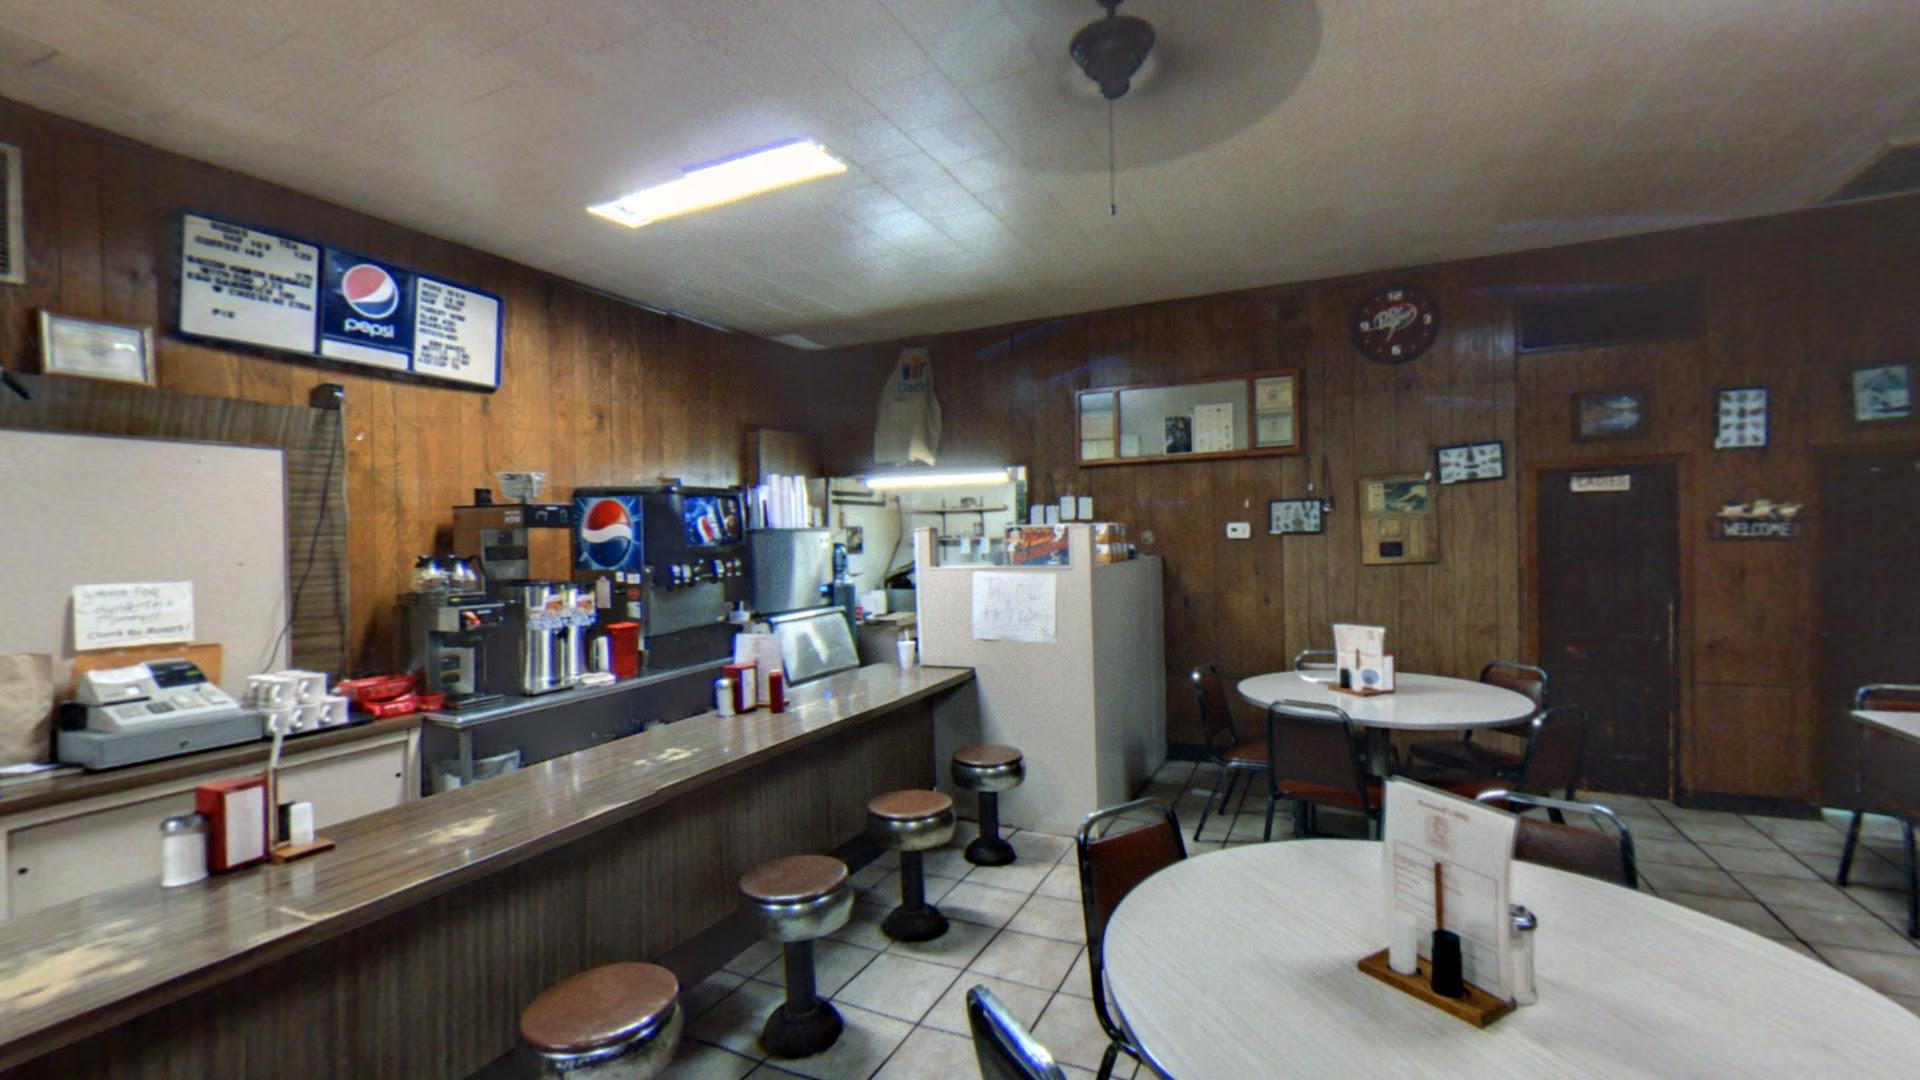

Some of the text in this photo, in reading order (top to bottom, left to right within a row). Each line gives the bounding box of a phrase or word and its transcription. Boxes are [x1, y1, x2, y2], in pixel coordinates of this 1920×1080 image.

[194, 236, 239, 253] COFFEE
[187, 254, 226, 269] BACON
[215, 276, 273, 297] SANDWICH
[1388, 291, 1403, 301] 12
[212, 307, 235, 319] PIE
[343, 318, 395, 339] pepsi
[1359, 313, 1432, 332] 9 3
[1391, 344, 1402, 355] 6
[1723, 522, 1793, 537] WELCOME
